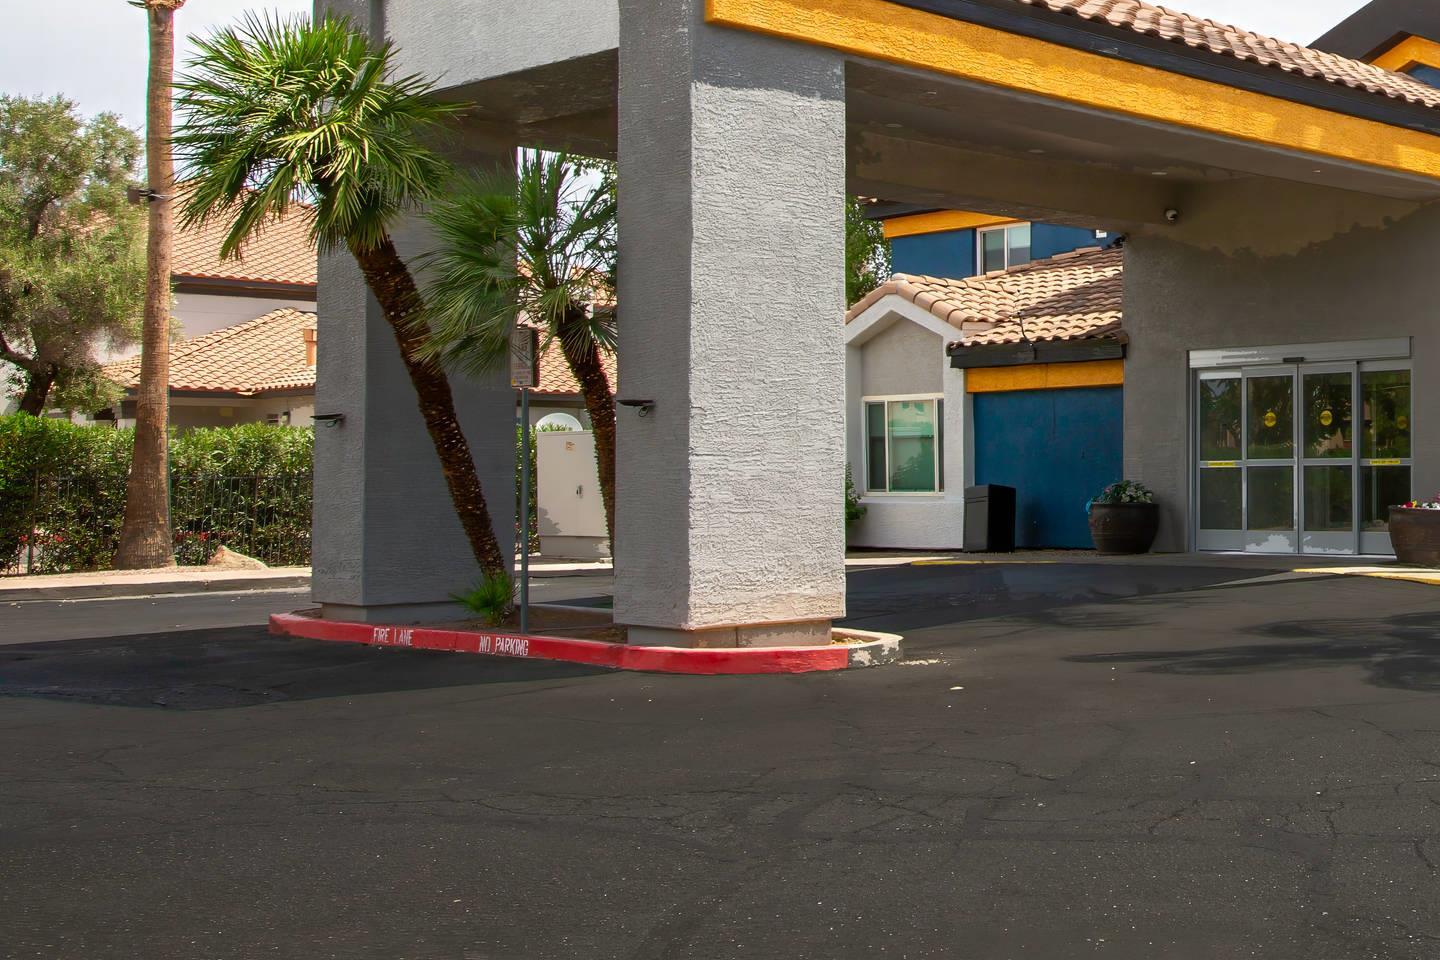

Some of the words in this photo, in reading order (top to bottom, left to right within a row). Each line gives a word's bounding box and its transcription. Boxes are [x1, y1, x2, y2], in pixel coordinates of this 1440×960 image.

[373, 628, 390, 643] FIRE
[394, 629, 414, 646] LANE
[478, 635, 491, 653] NO
[494, 637, 529, 656] PARKING
